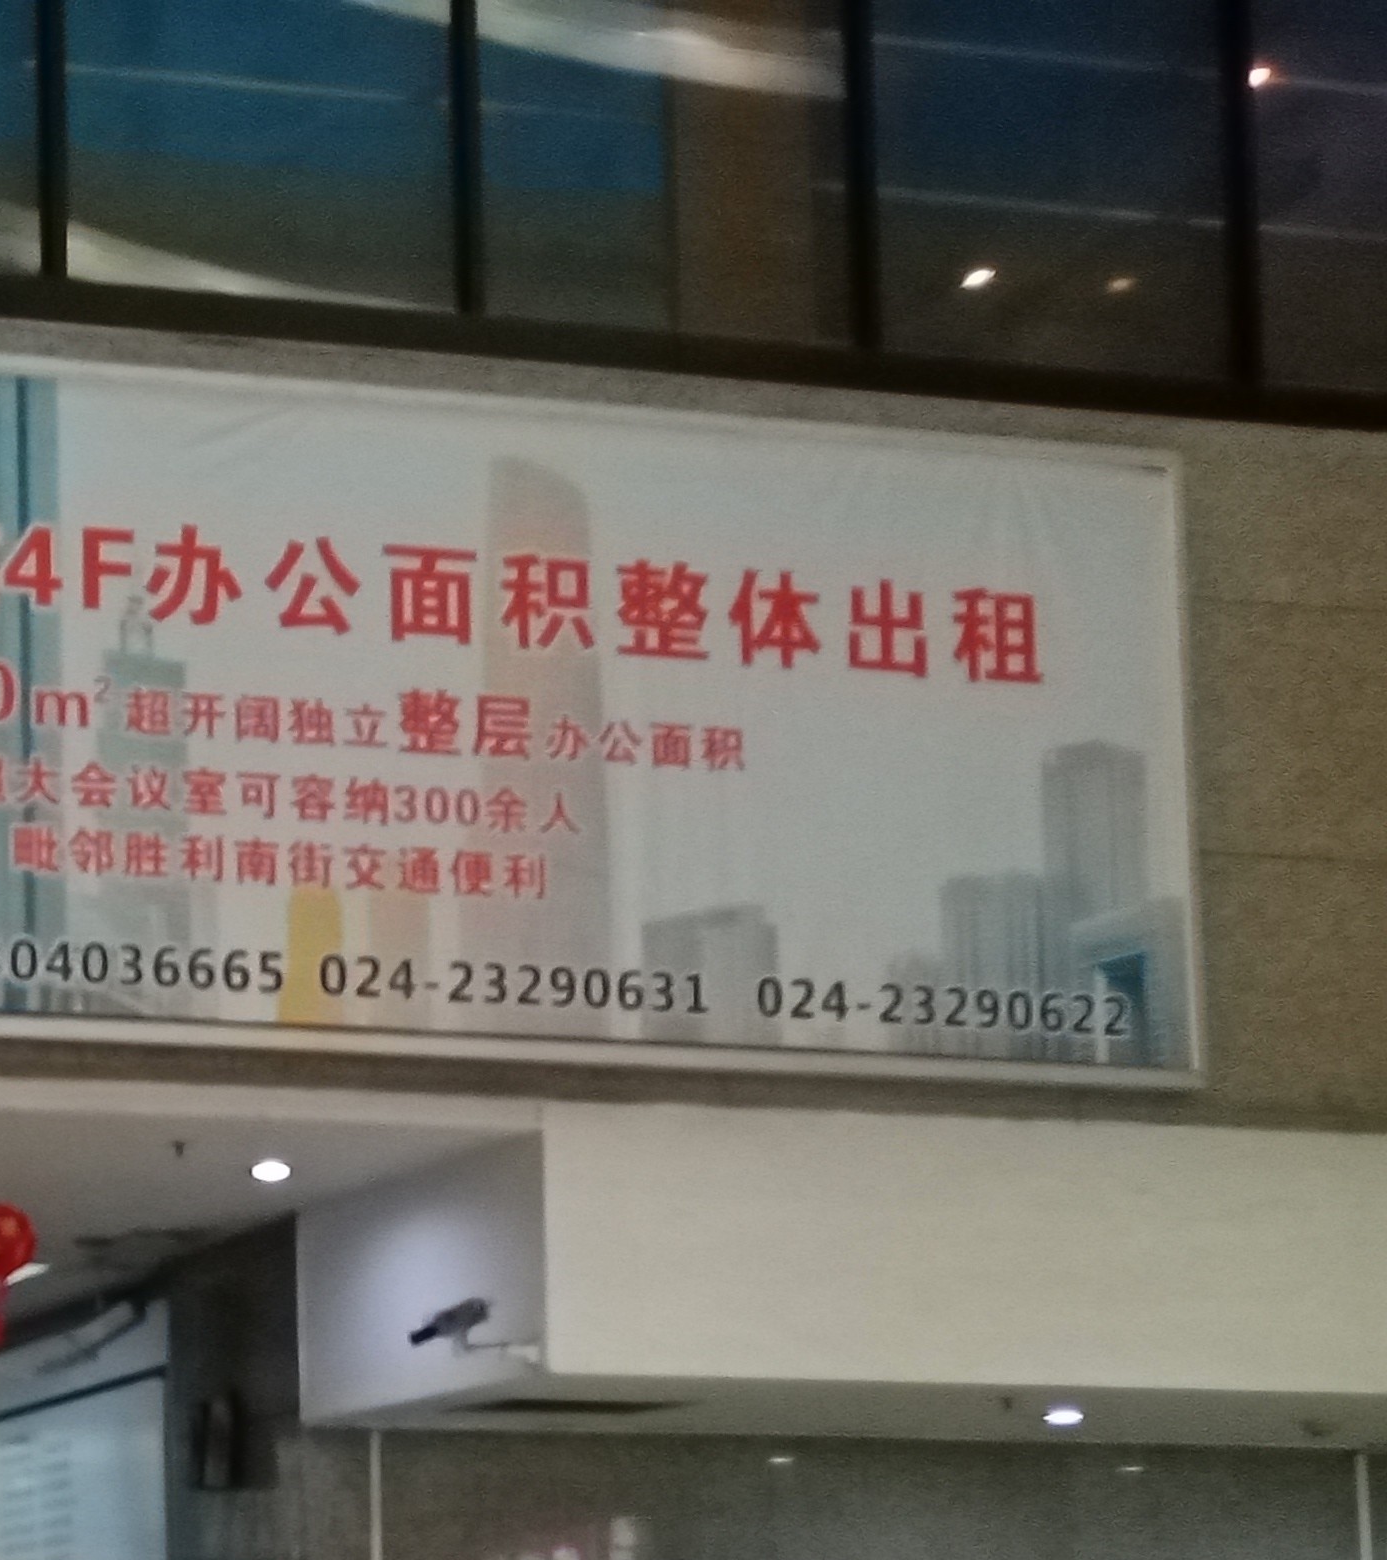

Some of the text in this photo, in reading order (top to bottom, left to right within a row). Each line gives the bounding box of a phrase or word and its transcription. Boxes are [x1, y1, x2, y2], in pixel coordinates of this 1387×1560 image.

[11, 826, 548, 900] 毗邻胜利南街交通便利
[318, 956, 709, 1016] 024-23290631
[755, 976, 1131, 1038] 024-23290622
